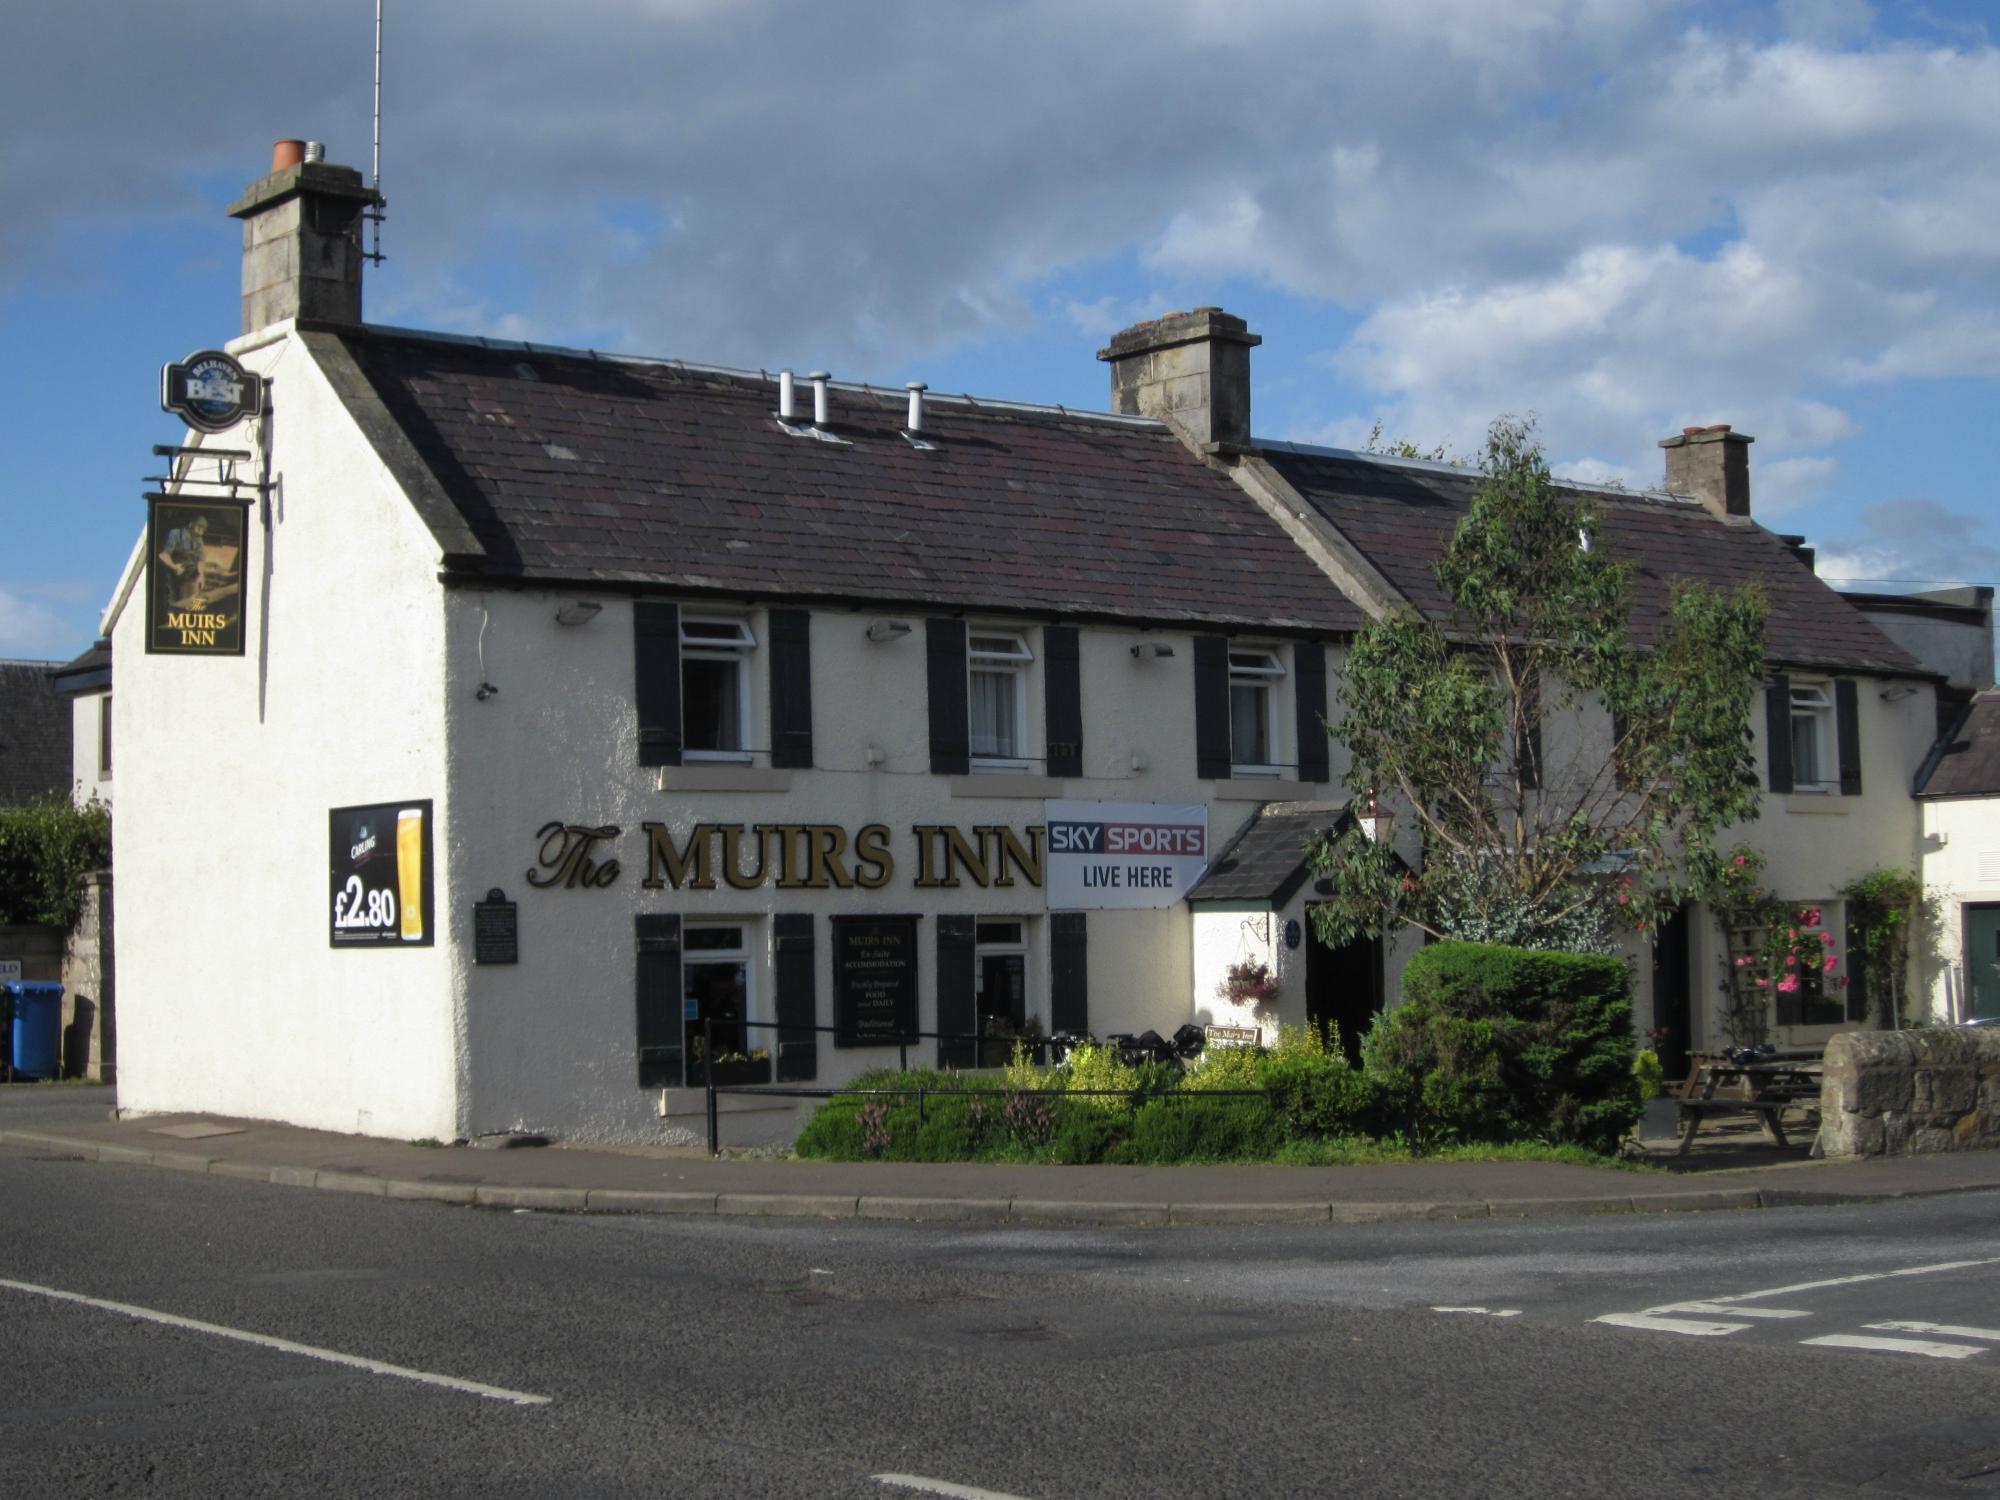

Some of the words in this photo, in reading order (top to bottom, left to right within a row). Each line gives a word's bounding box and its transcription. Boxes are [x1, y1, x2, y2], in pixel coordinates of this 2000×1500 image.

[192, 360, 238, 380] BELHAVEN
[186, 379, 244, 404] BEST
[168, 613, 225, 629] MUIRS
[181, 630, 215, 645] INN
[351, 835, 376, 859] CARLING
[1052, 826, 1099, 849] SKY
[1108, 827, 1201, 851] SPORTS
[527, 821, 620, 889] The
[642, 822, 894, 889] MUIRS
[912, 825, 1045, 888] INN
[1083, 865, 1121, 887] LIVE
[1127, 866, 1173, 888] HERE
[335, 875, 395, 928] £2.80
[848, 935, 880, 945] MUIRS
[882, 935, 900, 945] INN
[845, 960, 906, 968] ACCOMMODATION
